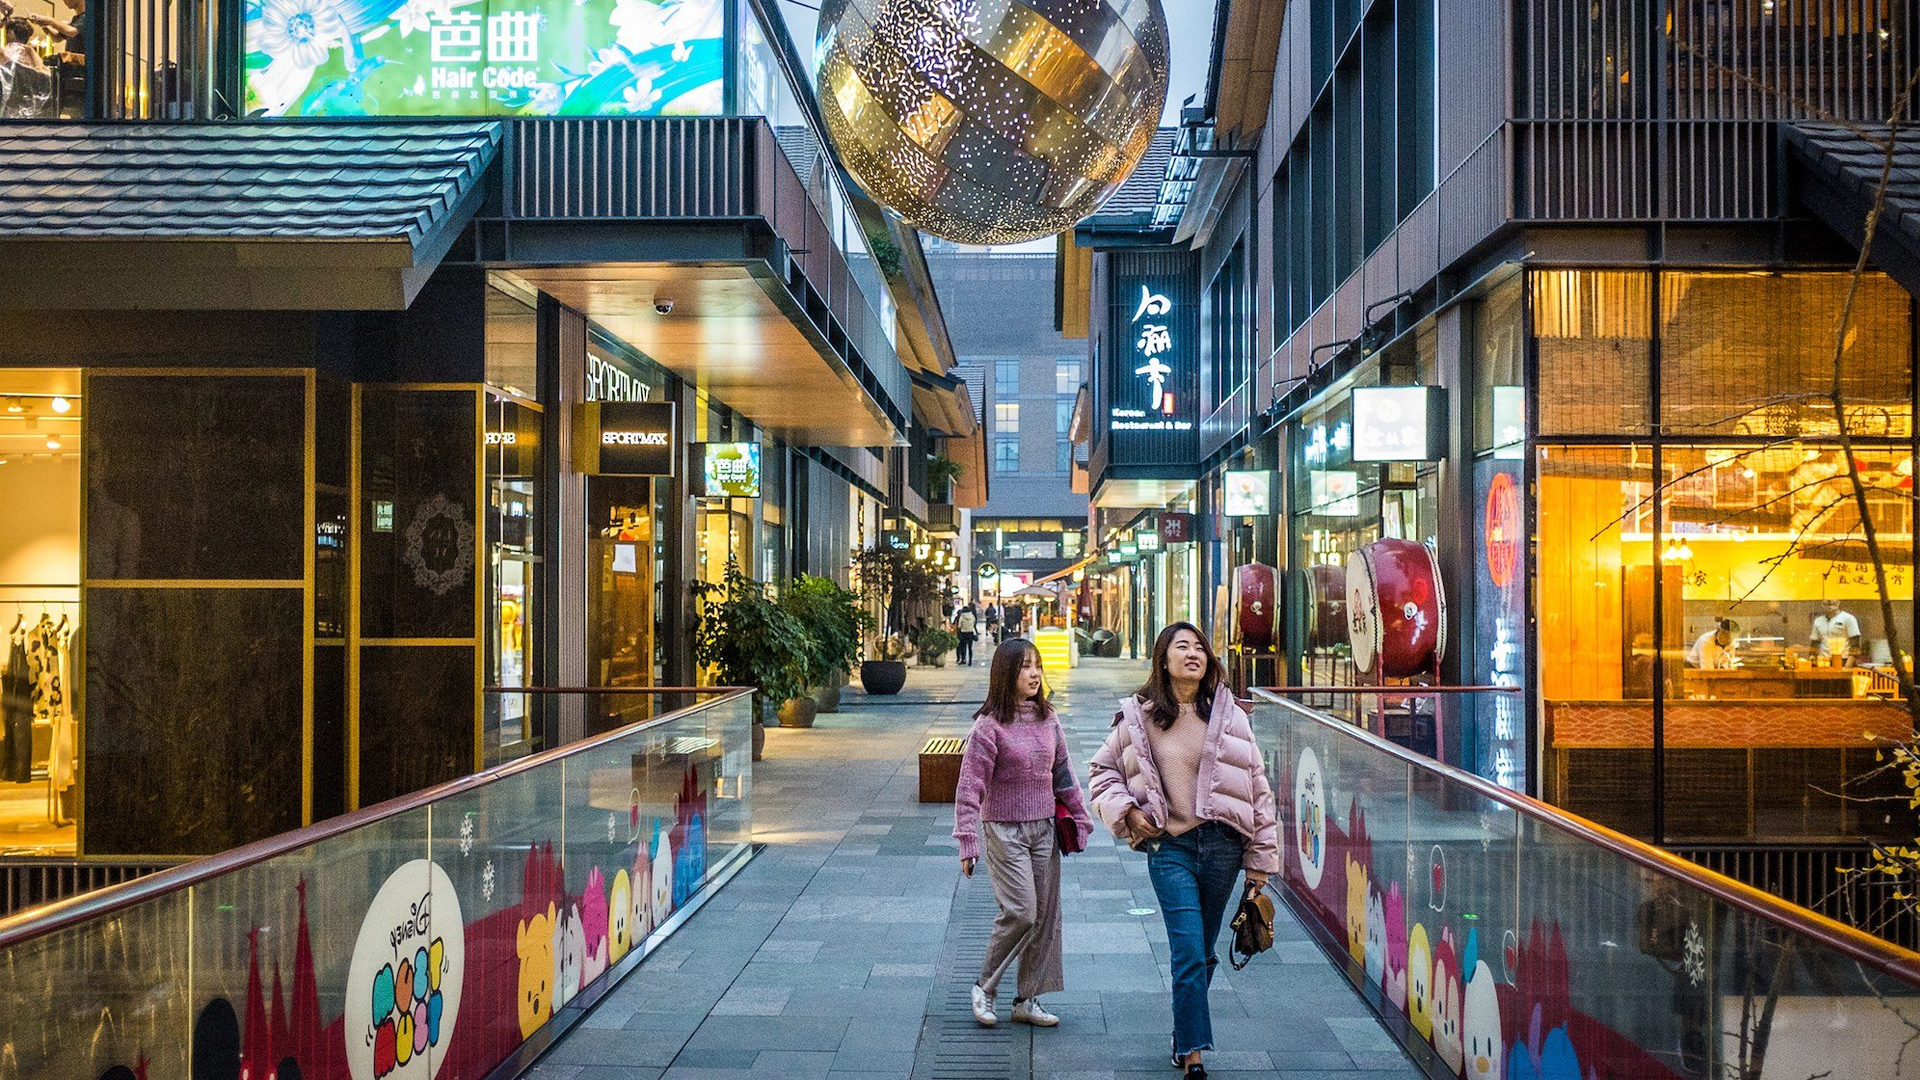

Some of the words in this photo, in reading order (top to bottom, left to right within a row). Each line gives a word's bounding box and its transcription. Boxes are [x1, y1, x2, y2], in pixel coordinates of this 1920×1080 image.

[430, 11, 538, 62] 芭曲
[431, 66, 477, 88] Hair
[482, 66, 538, 88] Code
[1111, 420, 1164, 430] Restaurant
[602, 431, 668, 445] SPORTMAX
